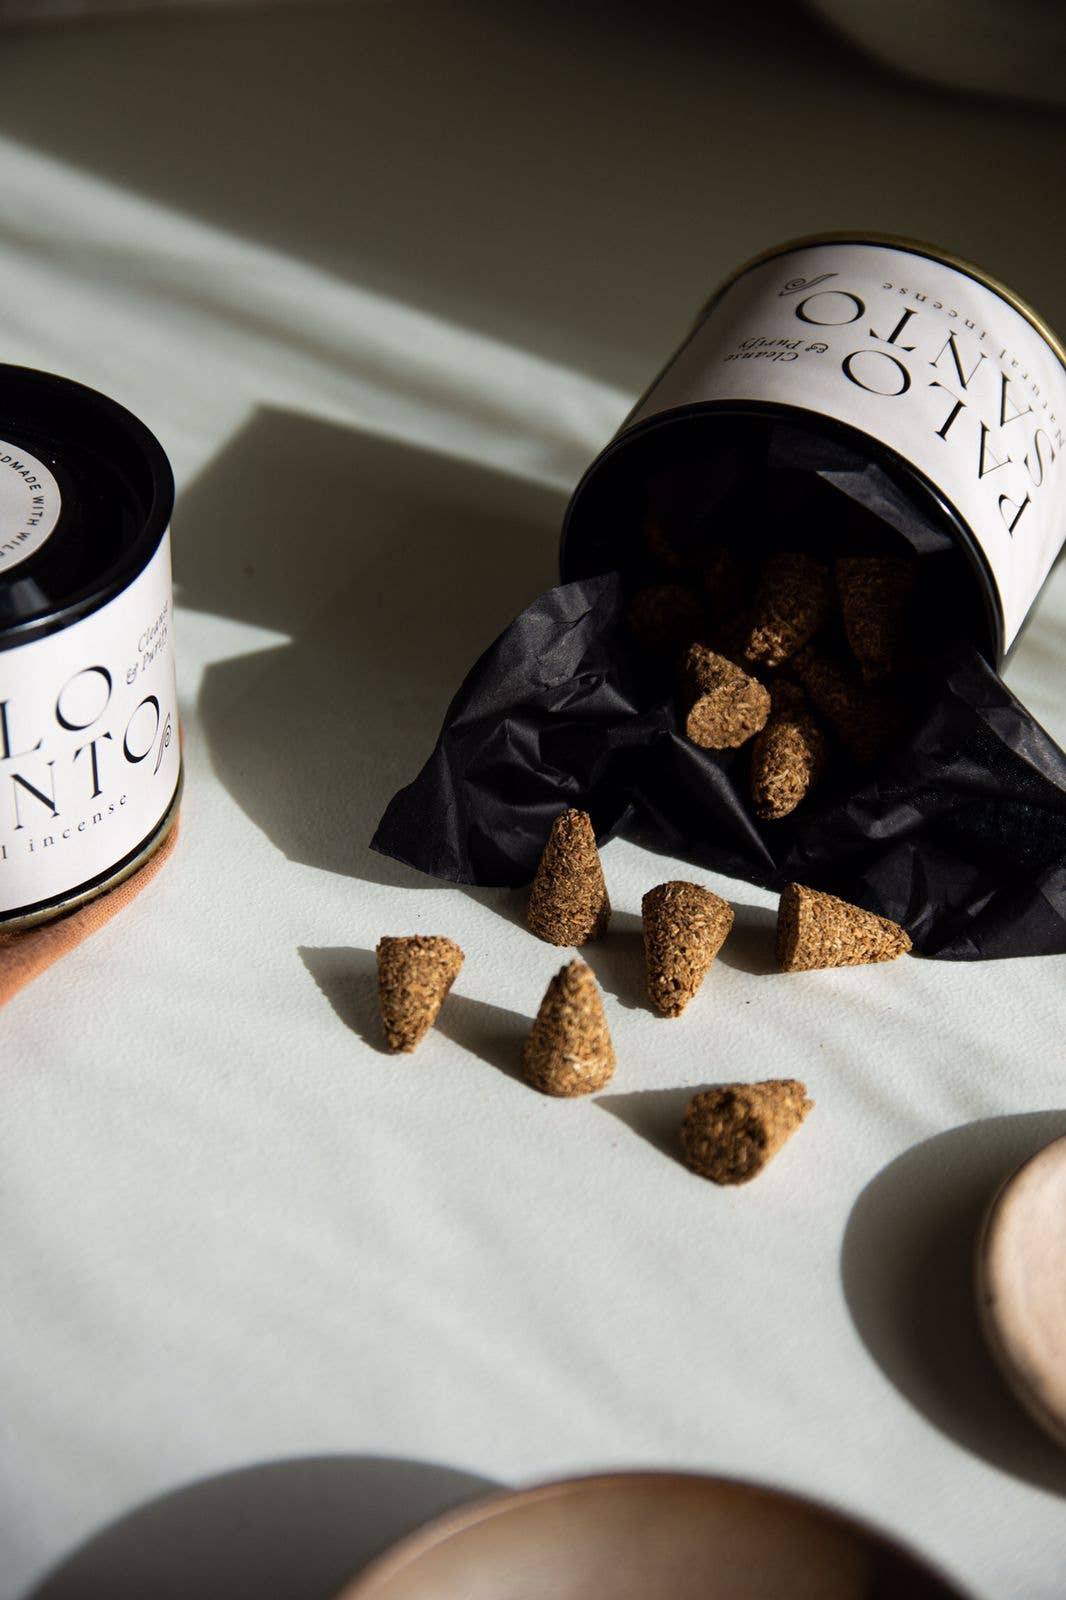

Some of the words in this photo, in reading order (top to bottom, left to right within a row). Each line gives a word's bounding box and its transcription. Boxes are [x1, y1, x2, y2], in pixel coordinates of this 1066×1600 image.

[882, 281, 987, 341] incense
[724, 350, 799, 362] Cleanse
[738, 336, 803, 350] Purify
[805, 342, 828, 354] &
[795, 290, 1056, 488] SANTO
[842, 350, 1032, 538] PALO
[0, 451, 42, 491] DMADE
[26, 495, 44, 526] WITH
[29, 793, 127, 852] incense
